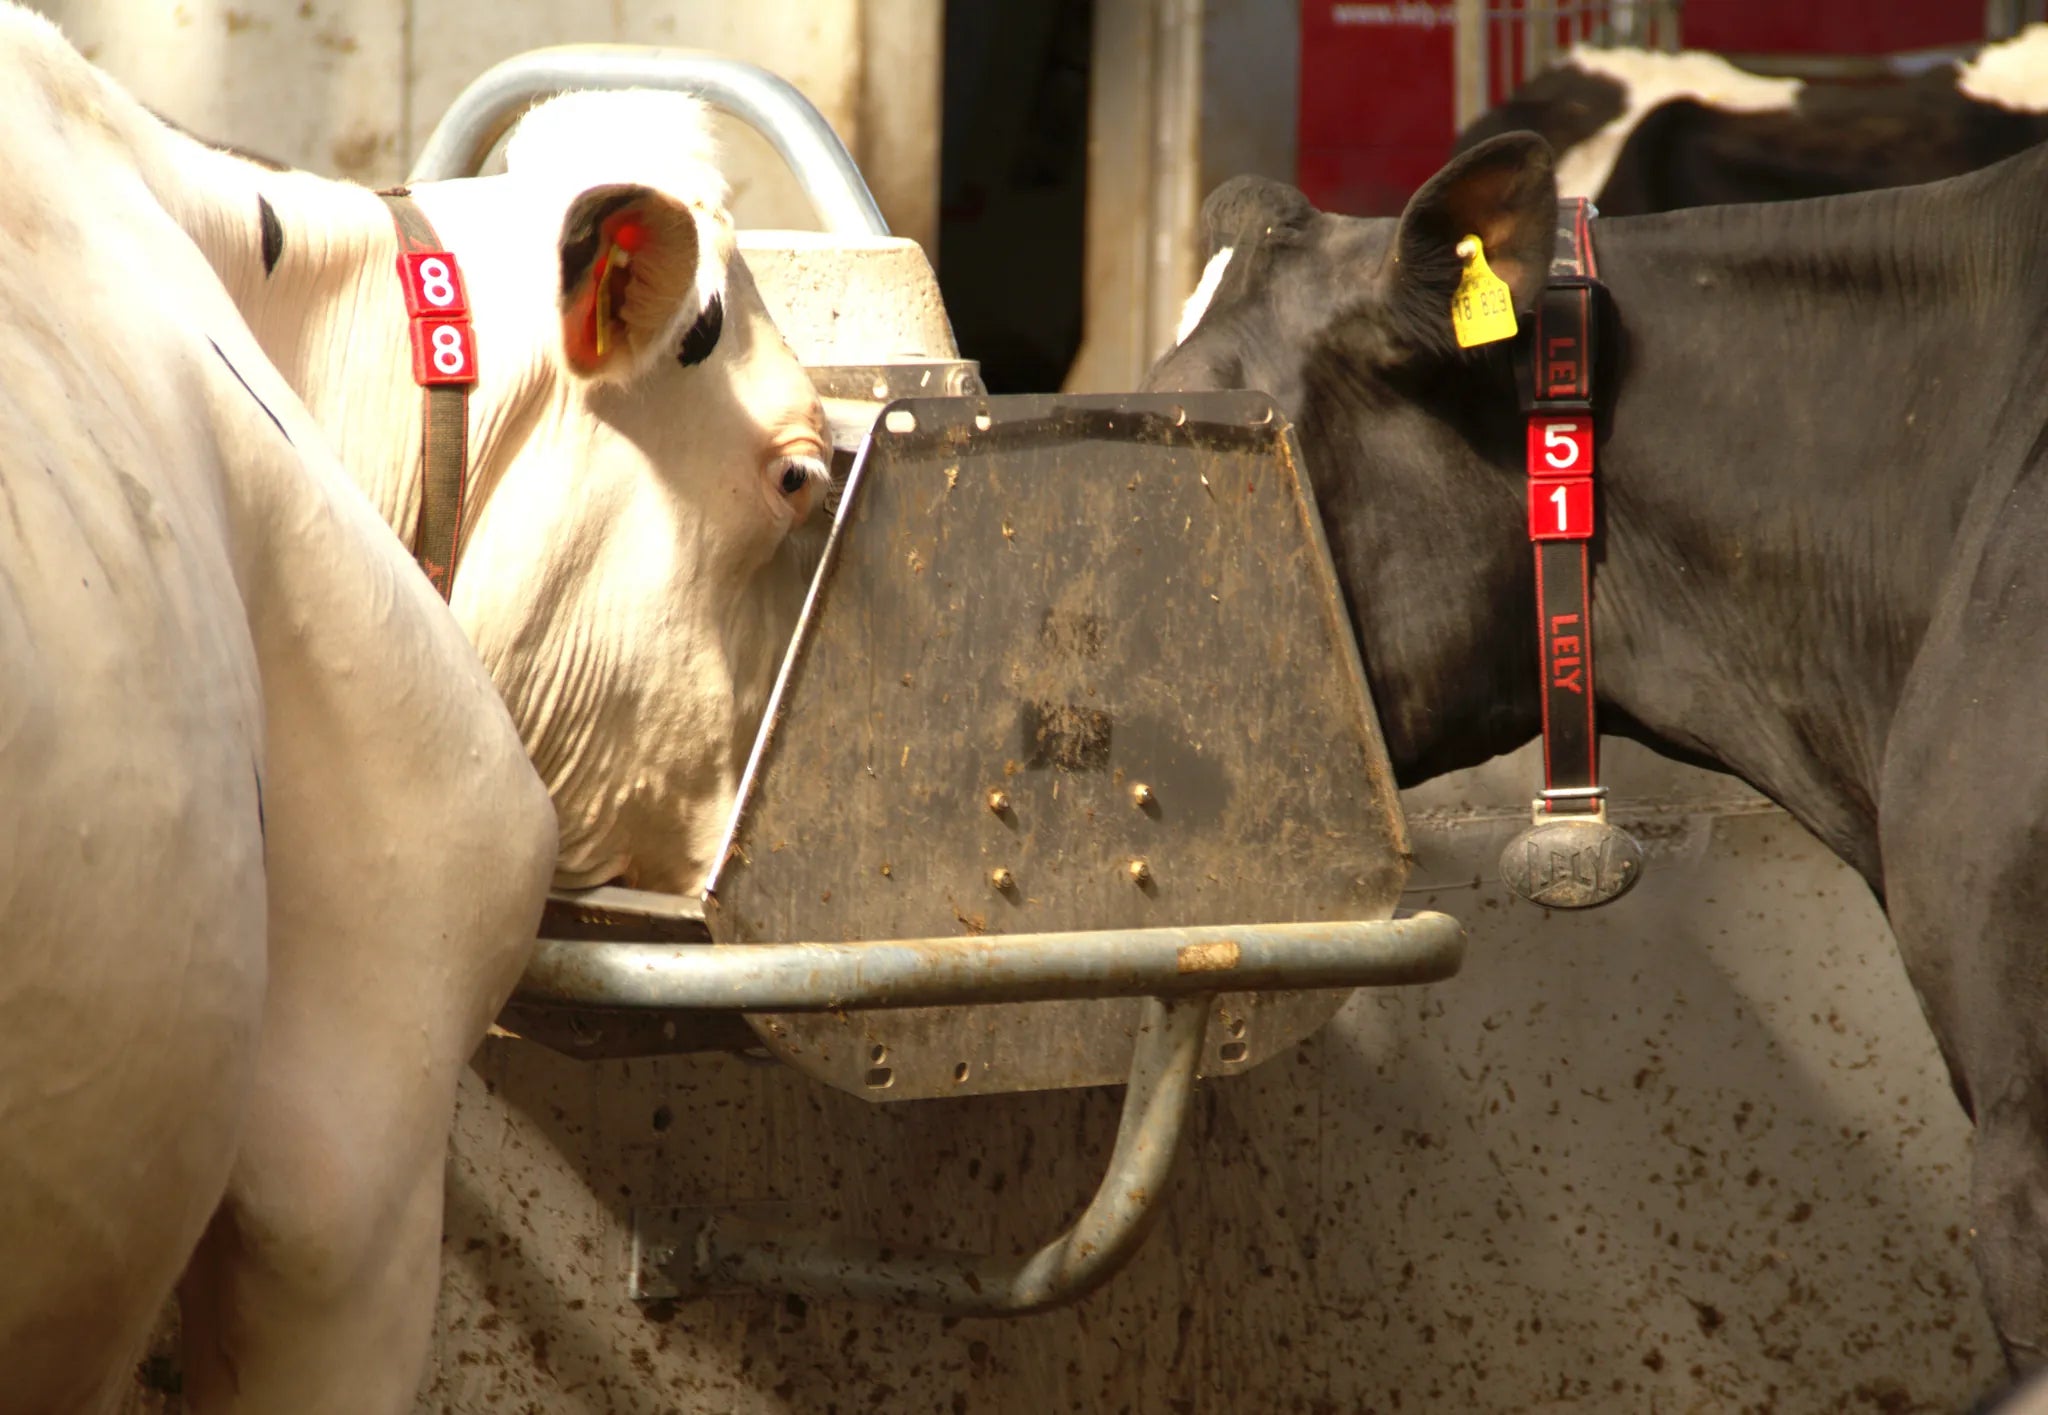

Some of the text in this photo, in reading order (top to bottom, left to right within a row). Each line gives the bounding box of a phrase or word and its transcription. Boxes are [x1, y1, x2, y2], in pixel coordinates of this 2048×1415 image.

[419, 257, 455, 307] 8
[431, 324, 465, 375] 8
[1544, 423, 1579, 469] 5
[1549, 485, 1568, 532] 1
[1551, 613, 1583, 695] LELY
